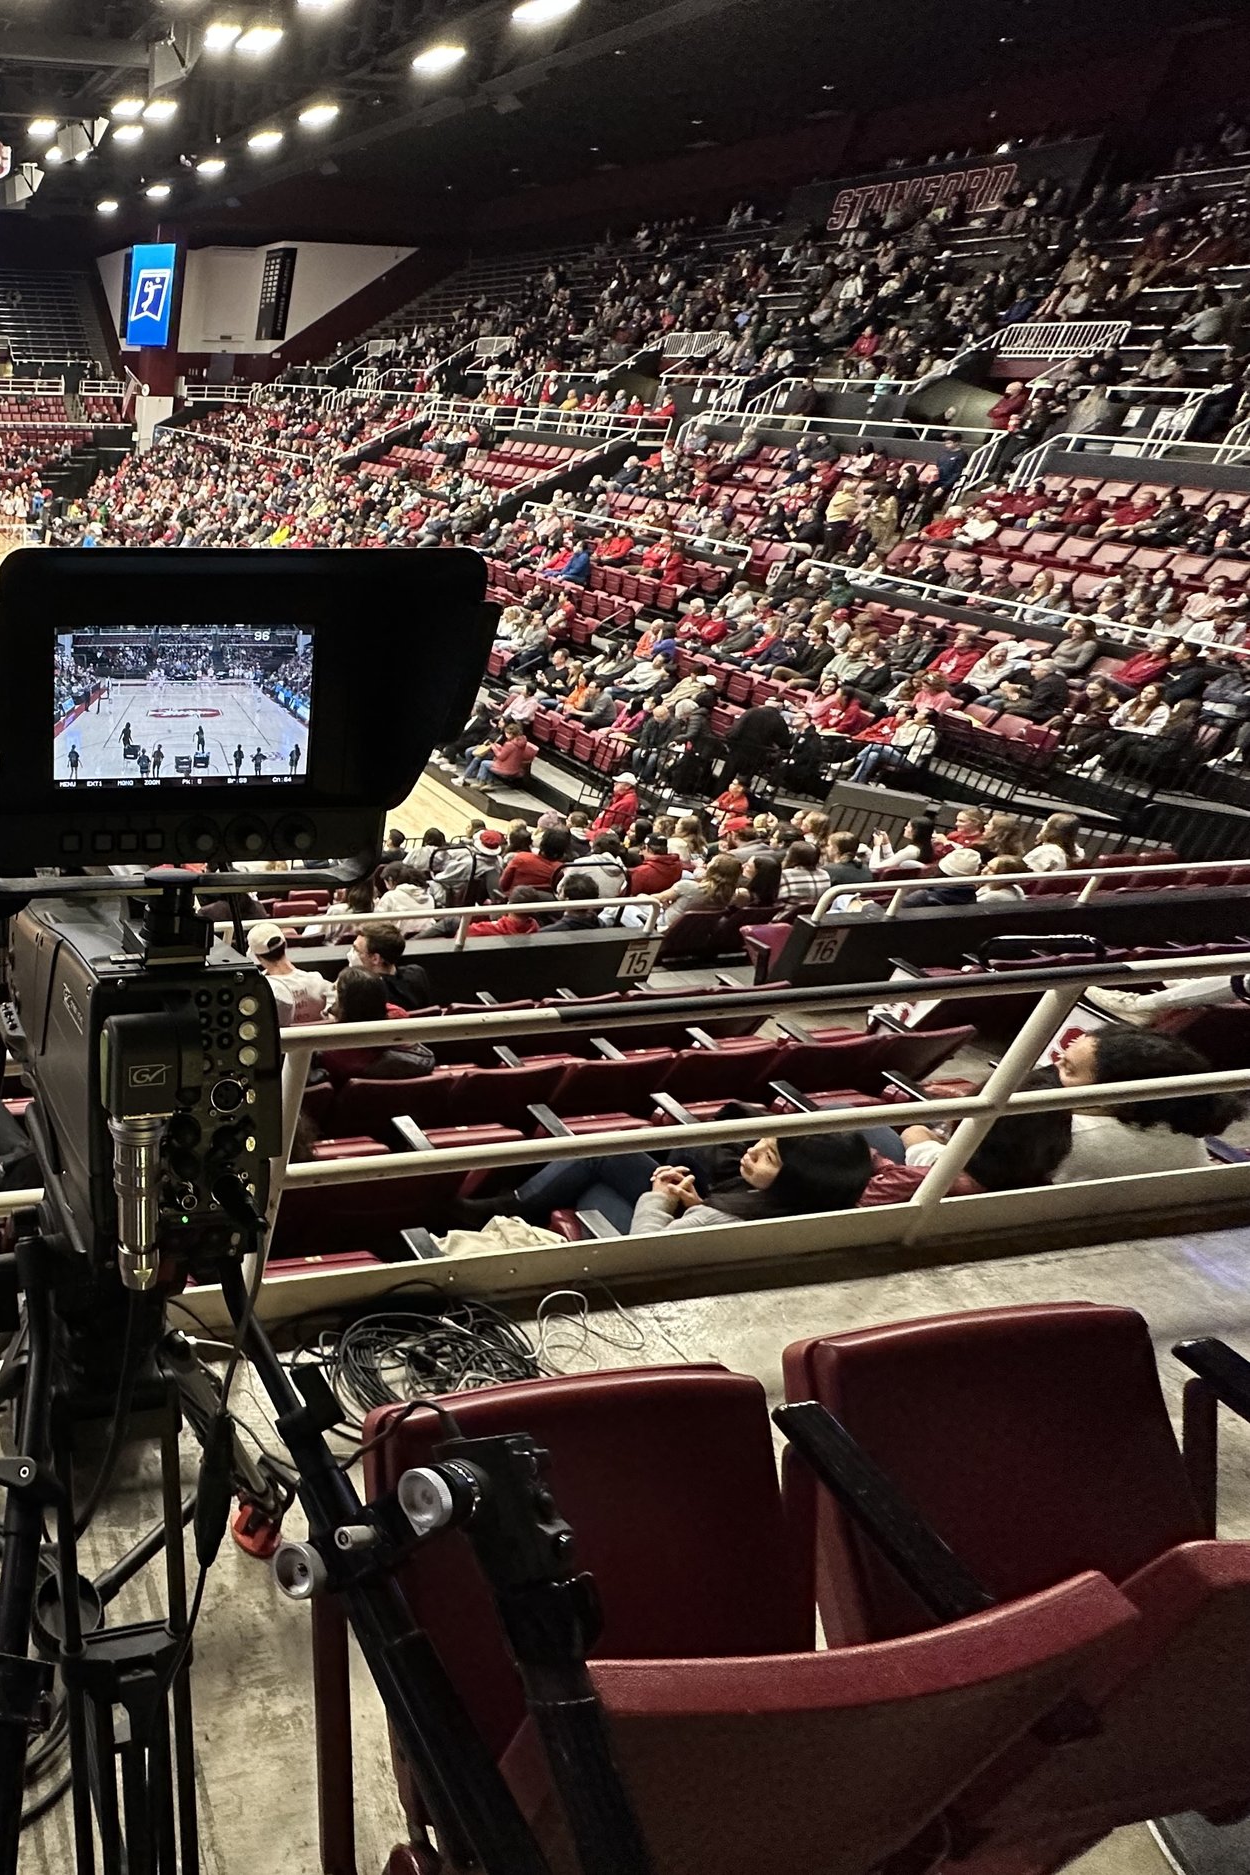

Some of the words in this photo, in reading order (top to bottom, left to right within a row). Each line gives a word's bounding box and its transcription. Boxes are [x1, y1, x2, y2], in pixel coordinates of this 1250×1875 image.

[254, 631, 270, 641] 96
[117, 779, 135, 787] MONO
[812, 939, 838, 962] 16
[626, 951, 651, 974] 15
